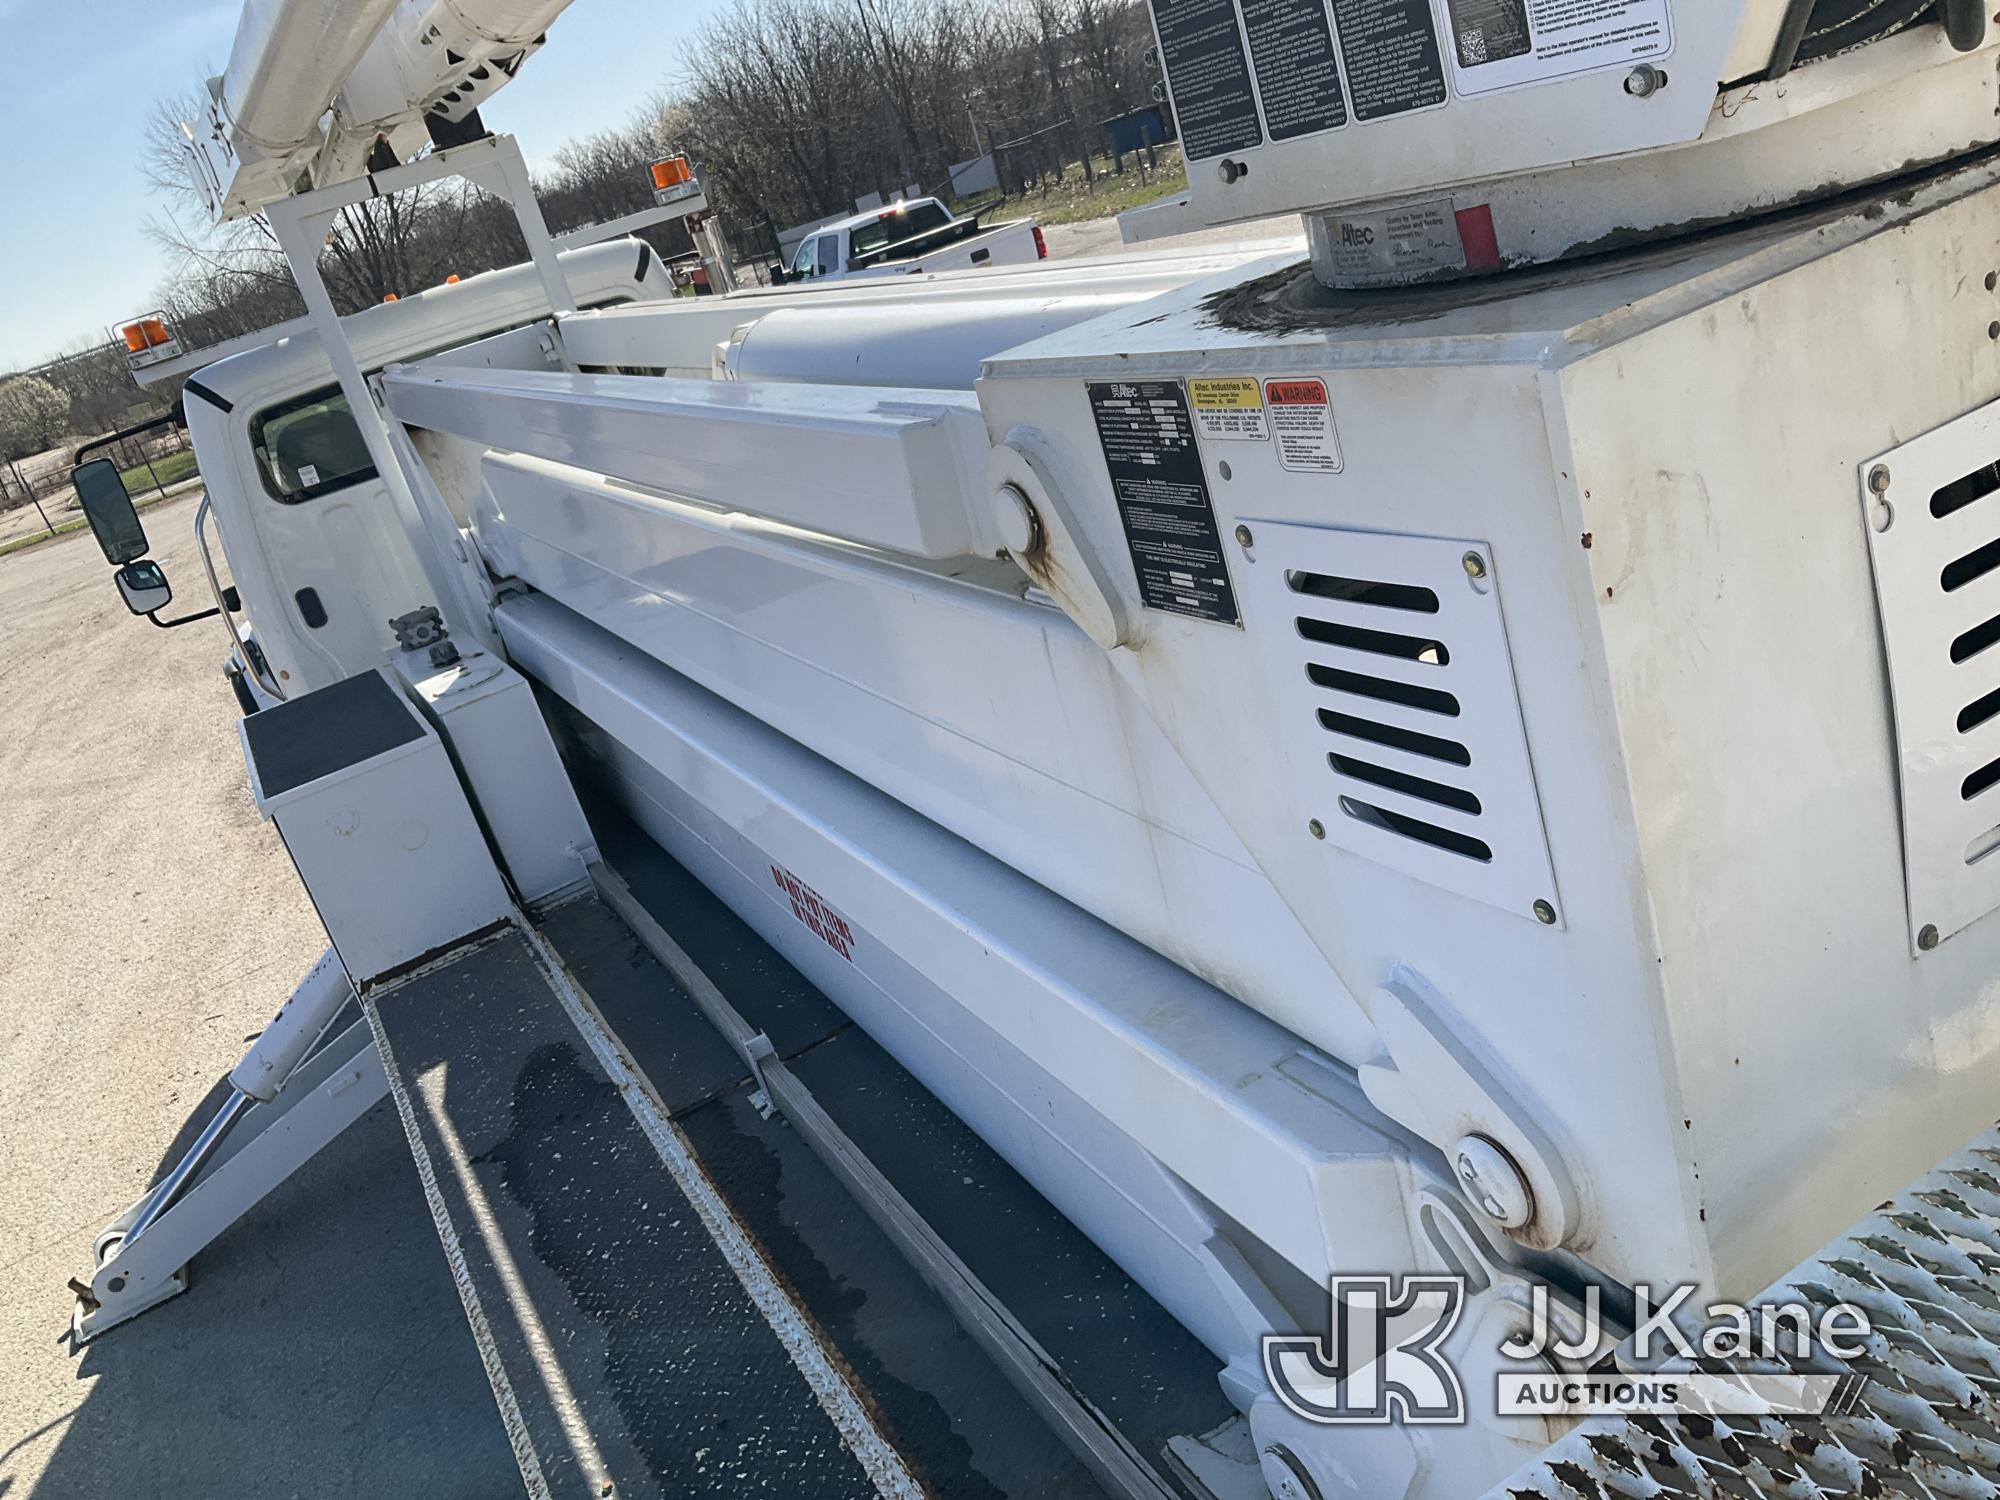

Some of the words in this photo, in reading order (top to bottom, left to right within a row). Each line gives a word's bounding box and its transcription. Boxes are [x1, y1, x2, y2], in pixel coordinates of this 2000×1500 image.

[1342, 224, 1374, 246] Altec
[1195, 382, 1208, 391] Altec
[1211, 382, 1240, 391] Industries
[1242, 382, 1253, 390] Inc.
[1282, 386, 1321, 400] WARNING
